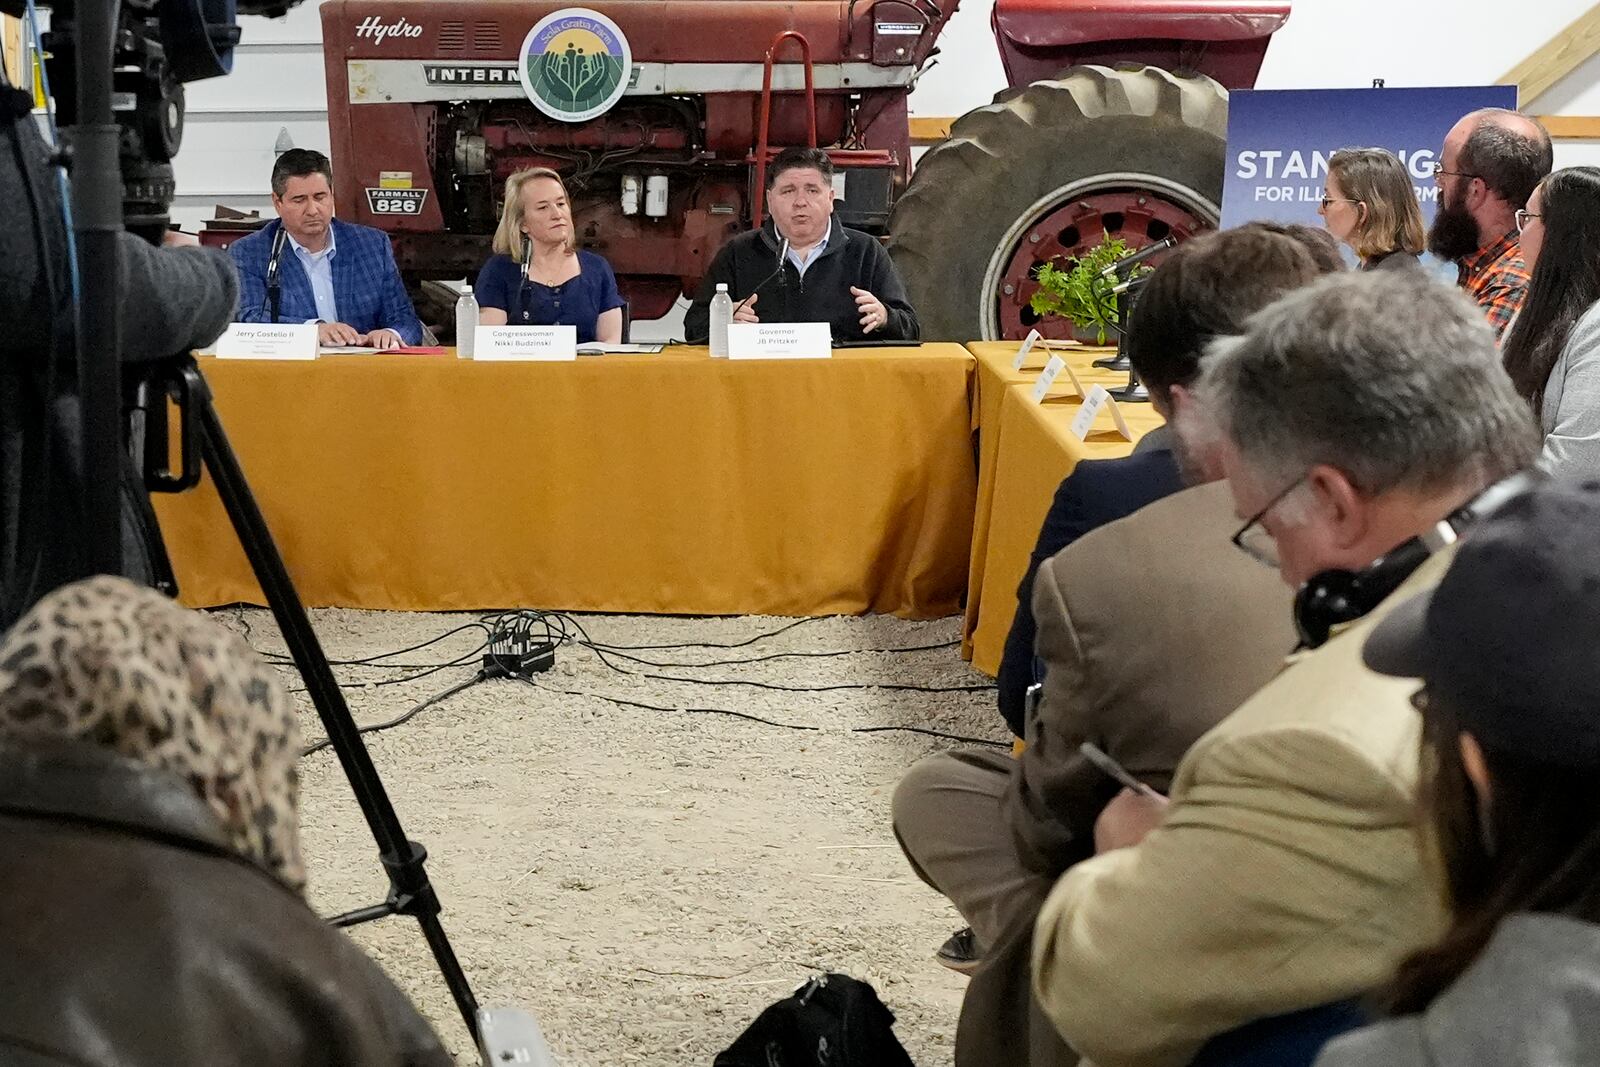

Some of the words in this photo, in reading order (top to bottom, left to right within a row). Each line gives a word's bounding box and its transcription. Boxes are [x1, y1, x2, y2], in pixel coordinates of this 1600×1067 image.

[355, 16, 423, 46] Hydro
[540, 26, 561, 45] Sola
[561, 20, 592, 30] Gratia
[592, 23, 613, 46] Farm
[430, 67, 522, 82] INTERN
[371, 190, 421, 198] FARMALL
[1255, 186, 1293, 202] FOR
[376, 199, 416, 213] 826
[235, 330, 255, 338] Jerry
[257, 330, 287, 338] Costello
[492, 330, 554, 338] Congresswoman
